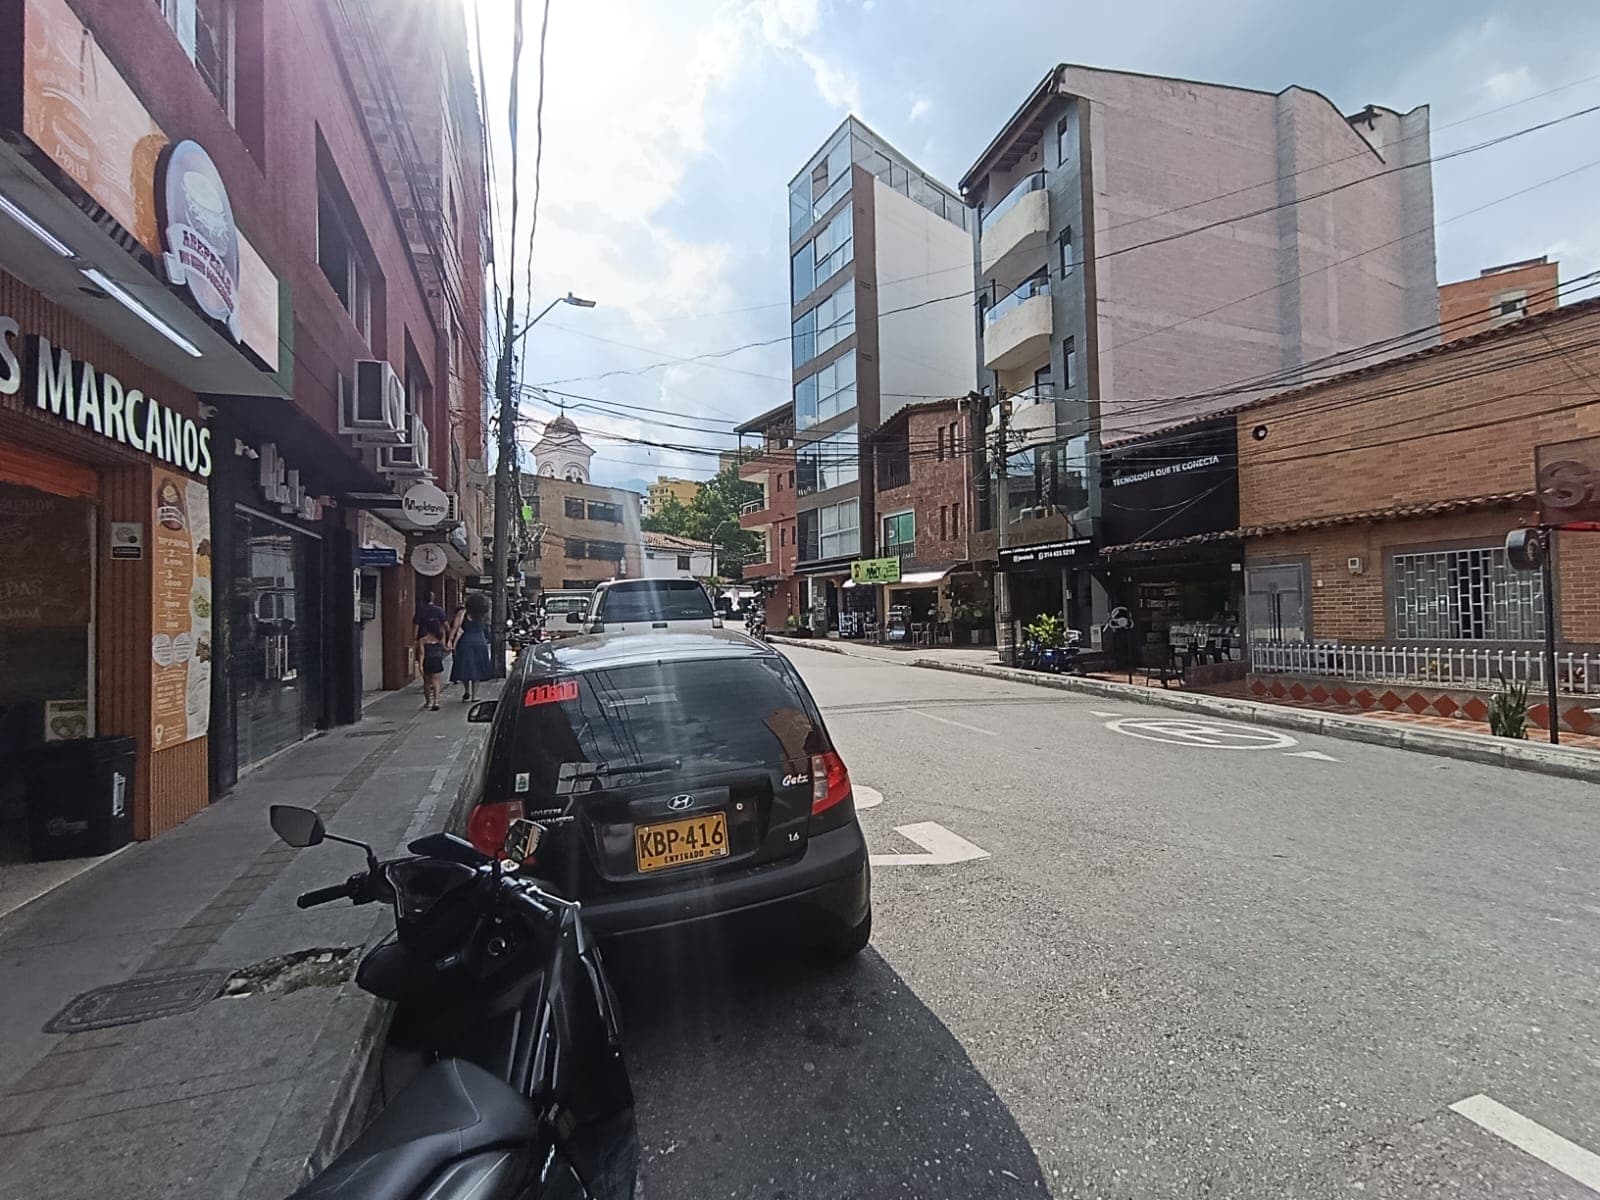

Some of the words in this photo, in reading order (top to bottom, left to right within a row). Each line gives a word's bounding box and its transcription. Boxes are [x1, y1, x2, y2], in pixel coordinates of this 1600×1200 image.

[36, 335, 212, 478] MARCANOS
[1155, 465, 1171, 477] QUE
[1172, 463, 1181, 473] TE
[1181, 455, 1220, 470] CONECTA
[529, 682, 577, 701] 11:11
[782, 773, 809, 786] Getz
[640, 820, 724, 859] KBP-416
[664, 849, 704, 864] ENVIGADO
